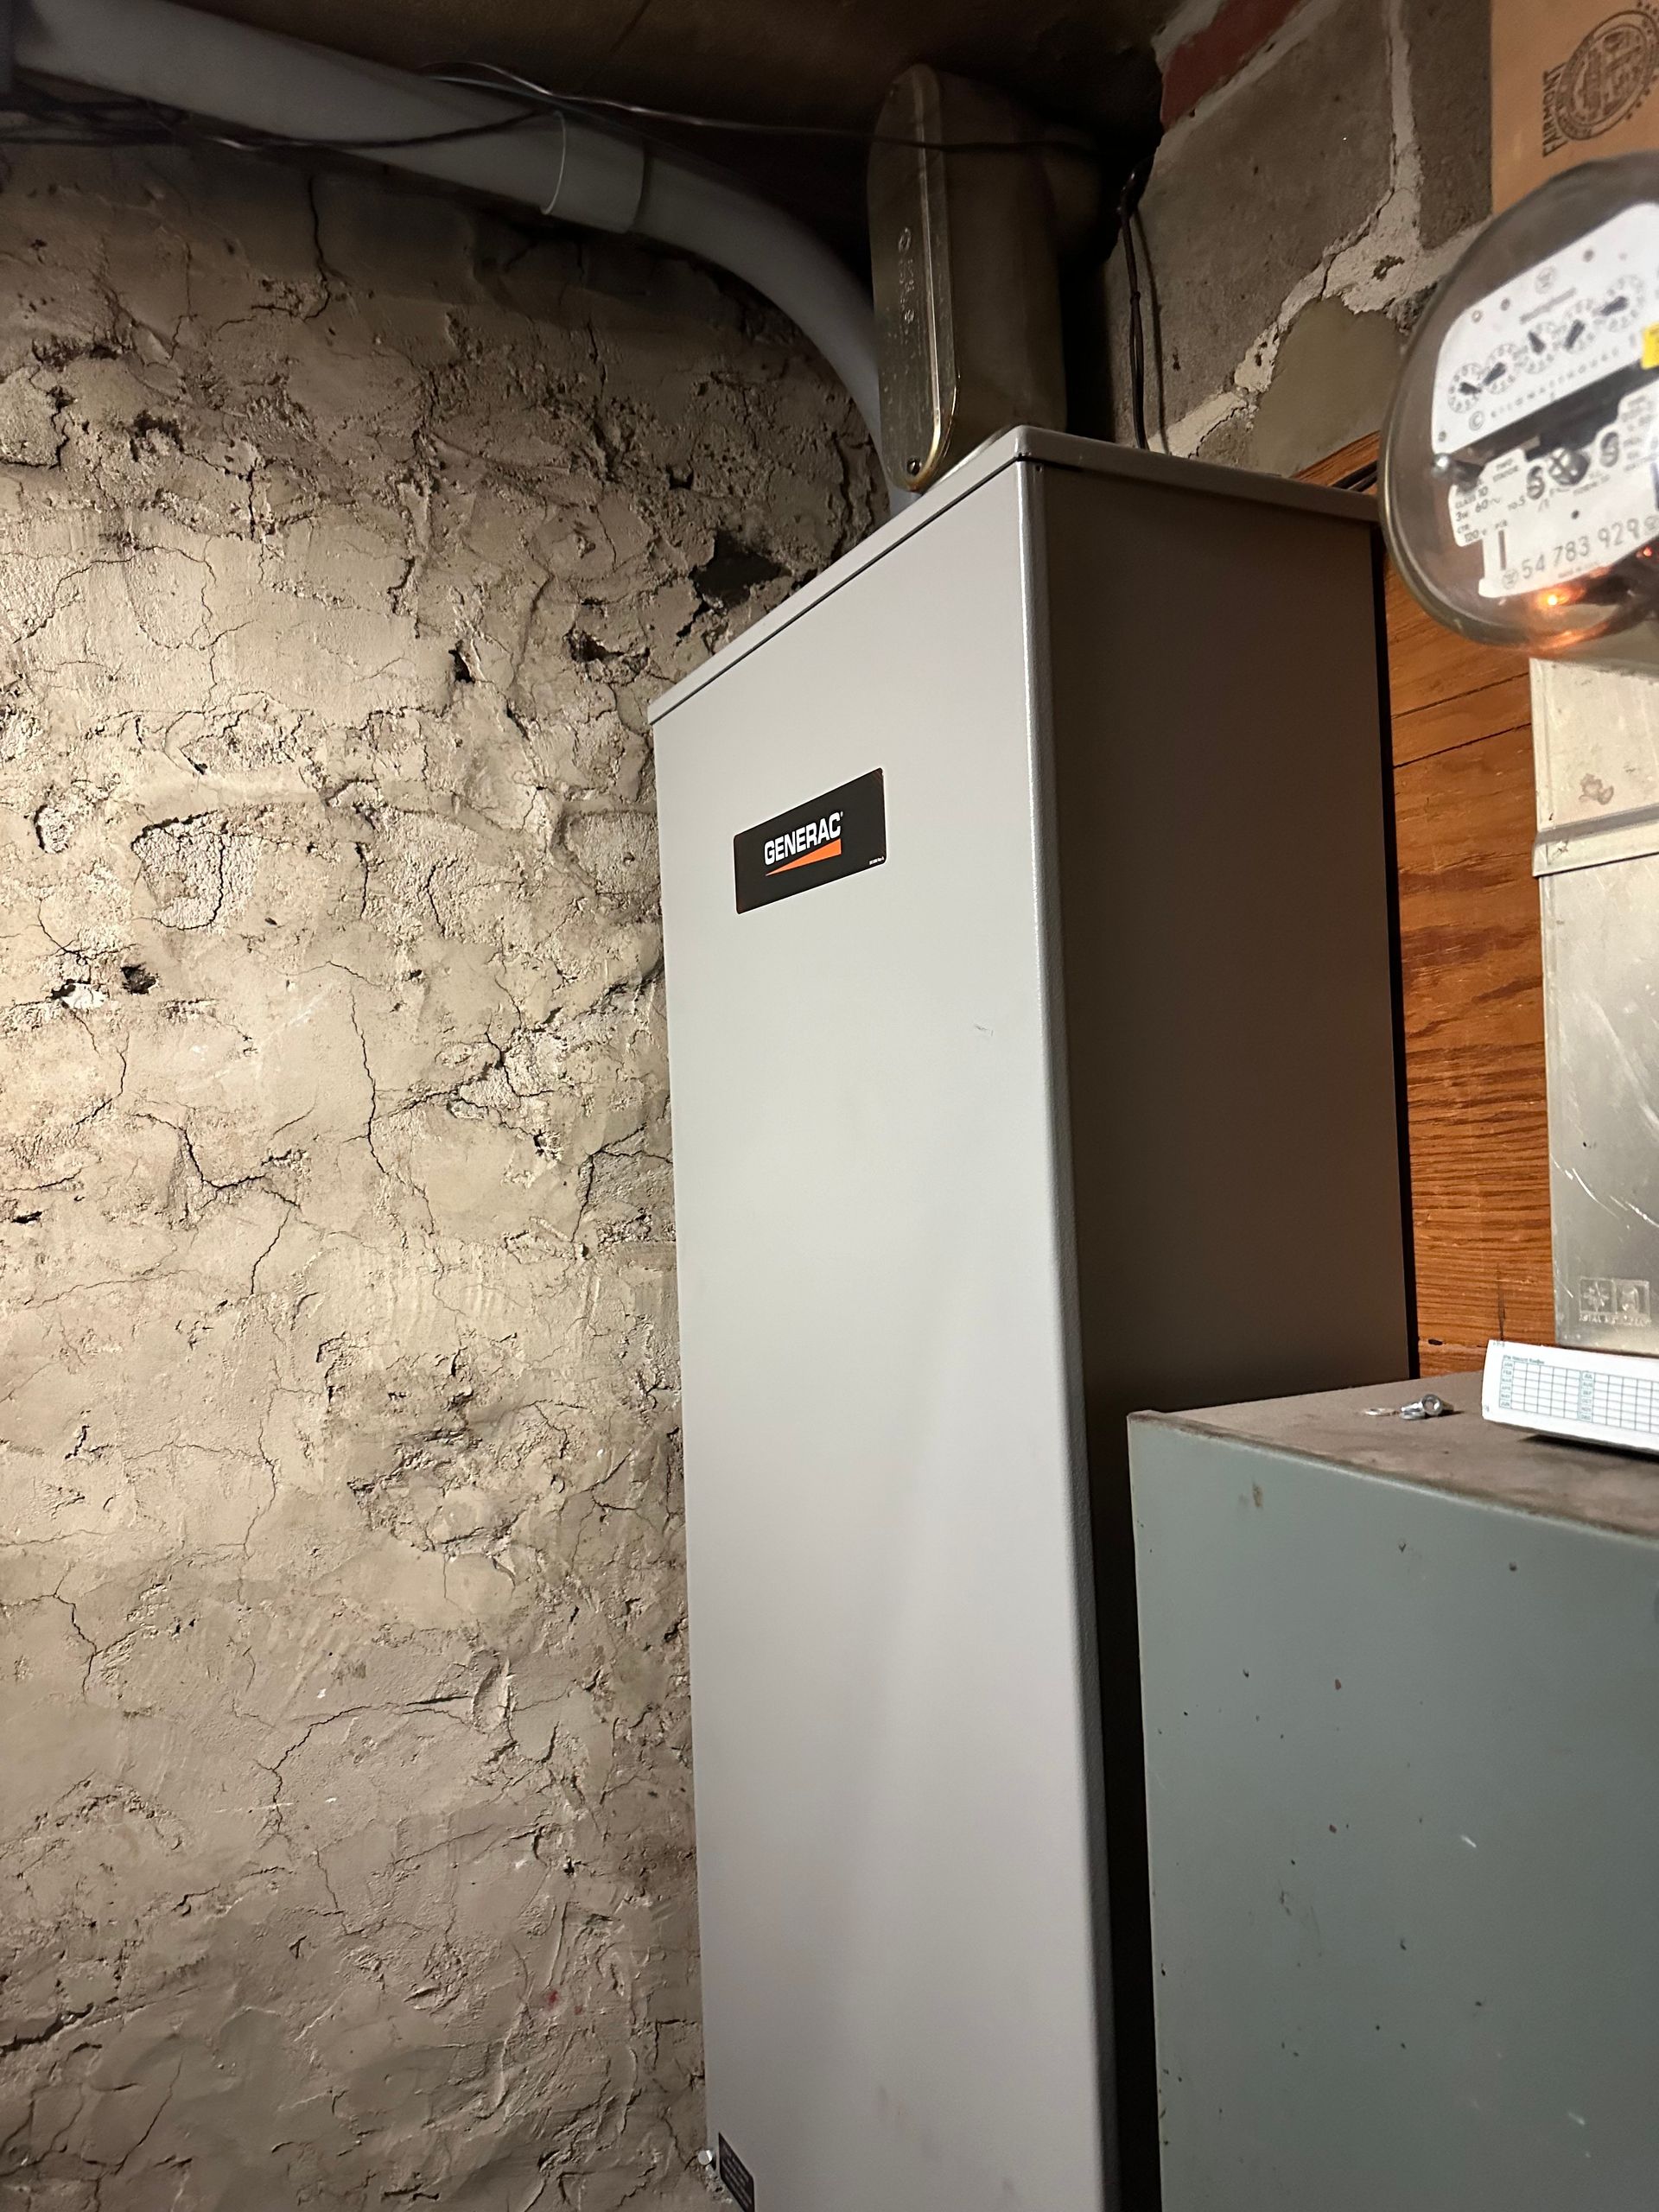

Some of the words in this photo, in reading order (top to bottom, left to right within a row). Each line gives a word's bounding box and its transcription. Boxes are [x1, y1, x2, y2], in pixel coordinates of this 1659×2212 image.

[1522, 554, 1546, 580] 54
[1553, 535, 1591, 567] 783
[1598, 518, 1640, 548] 929
[764, 811, 842, 866] GENERAC
